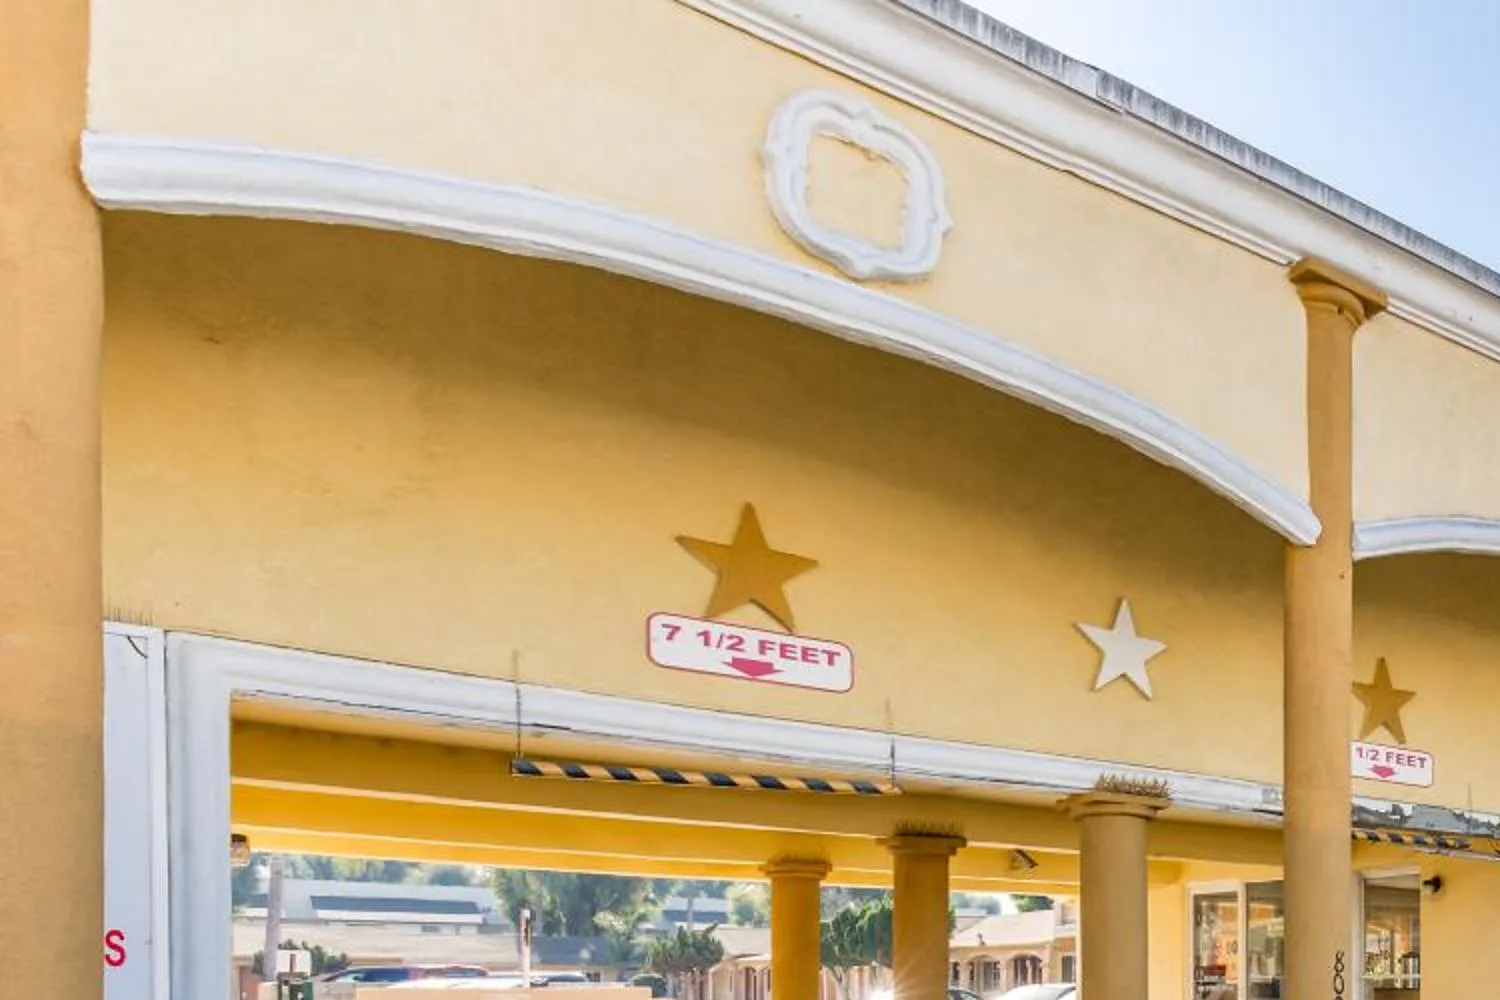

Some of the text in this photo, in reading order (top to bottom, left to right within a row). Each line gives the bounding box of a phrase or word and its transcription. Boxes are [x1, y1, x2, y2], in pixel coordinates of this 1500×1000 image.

[661, 623, 842, 667] 7 1/2 FEET
[1355, 747, 1427, 769] 1/2 FEET
